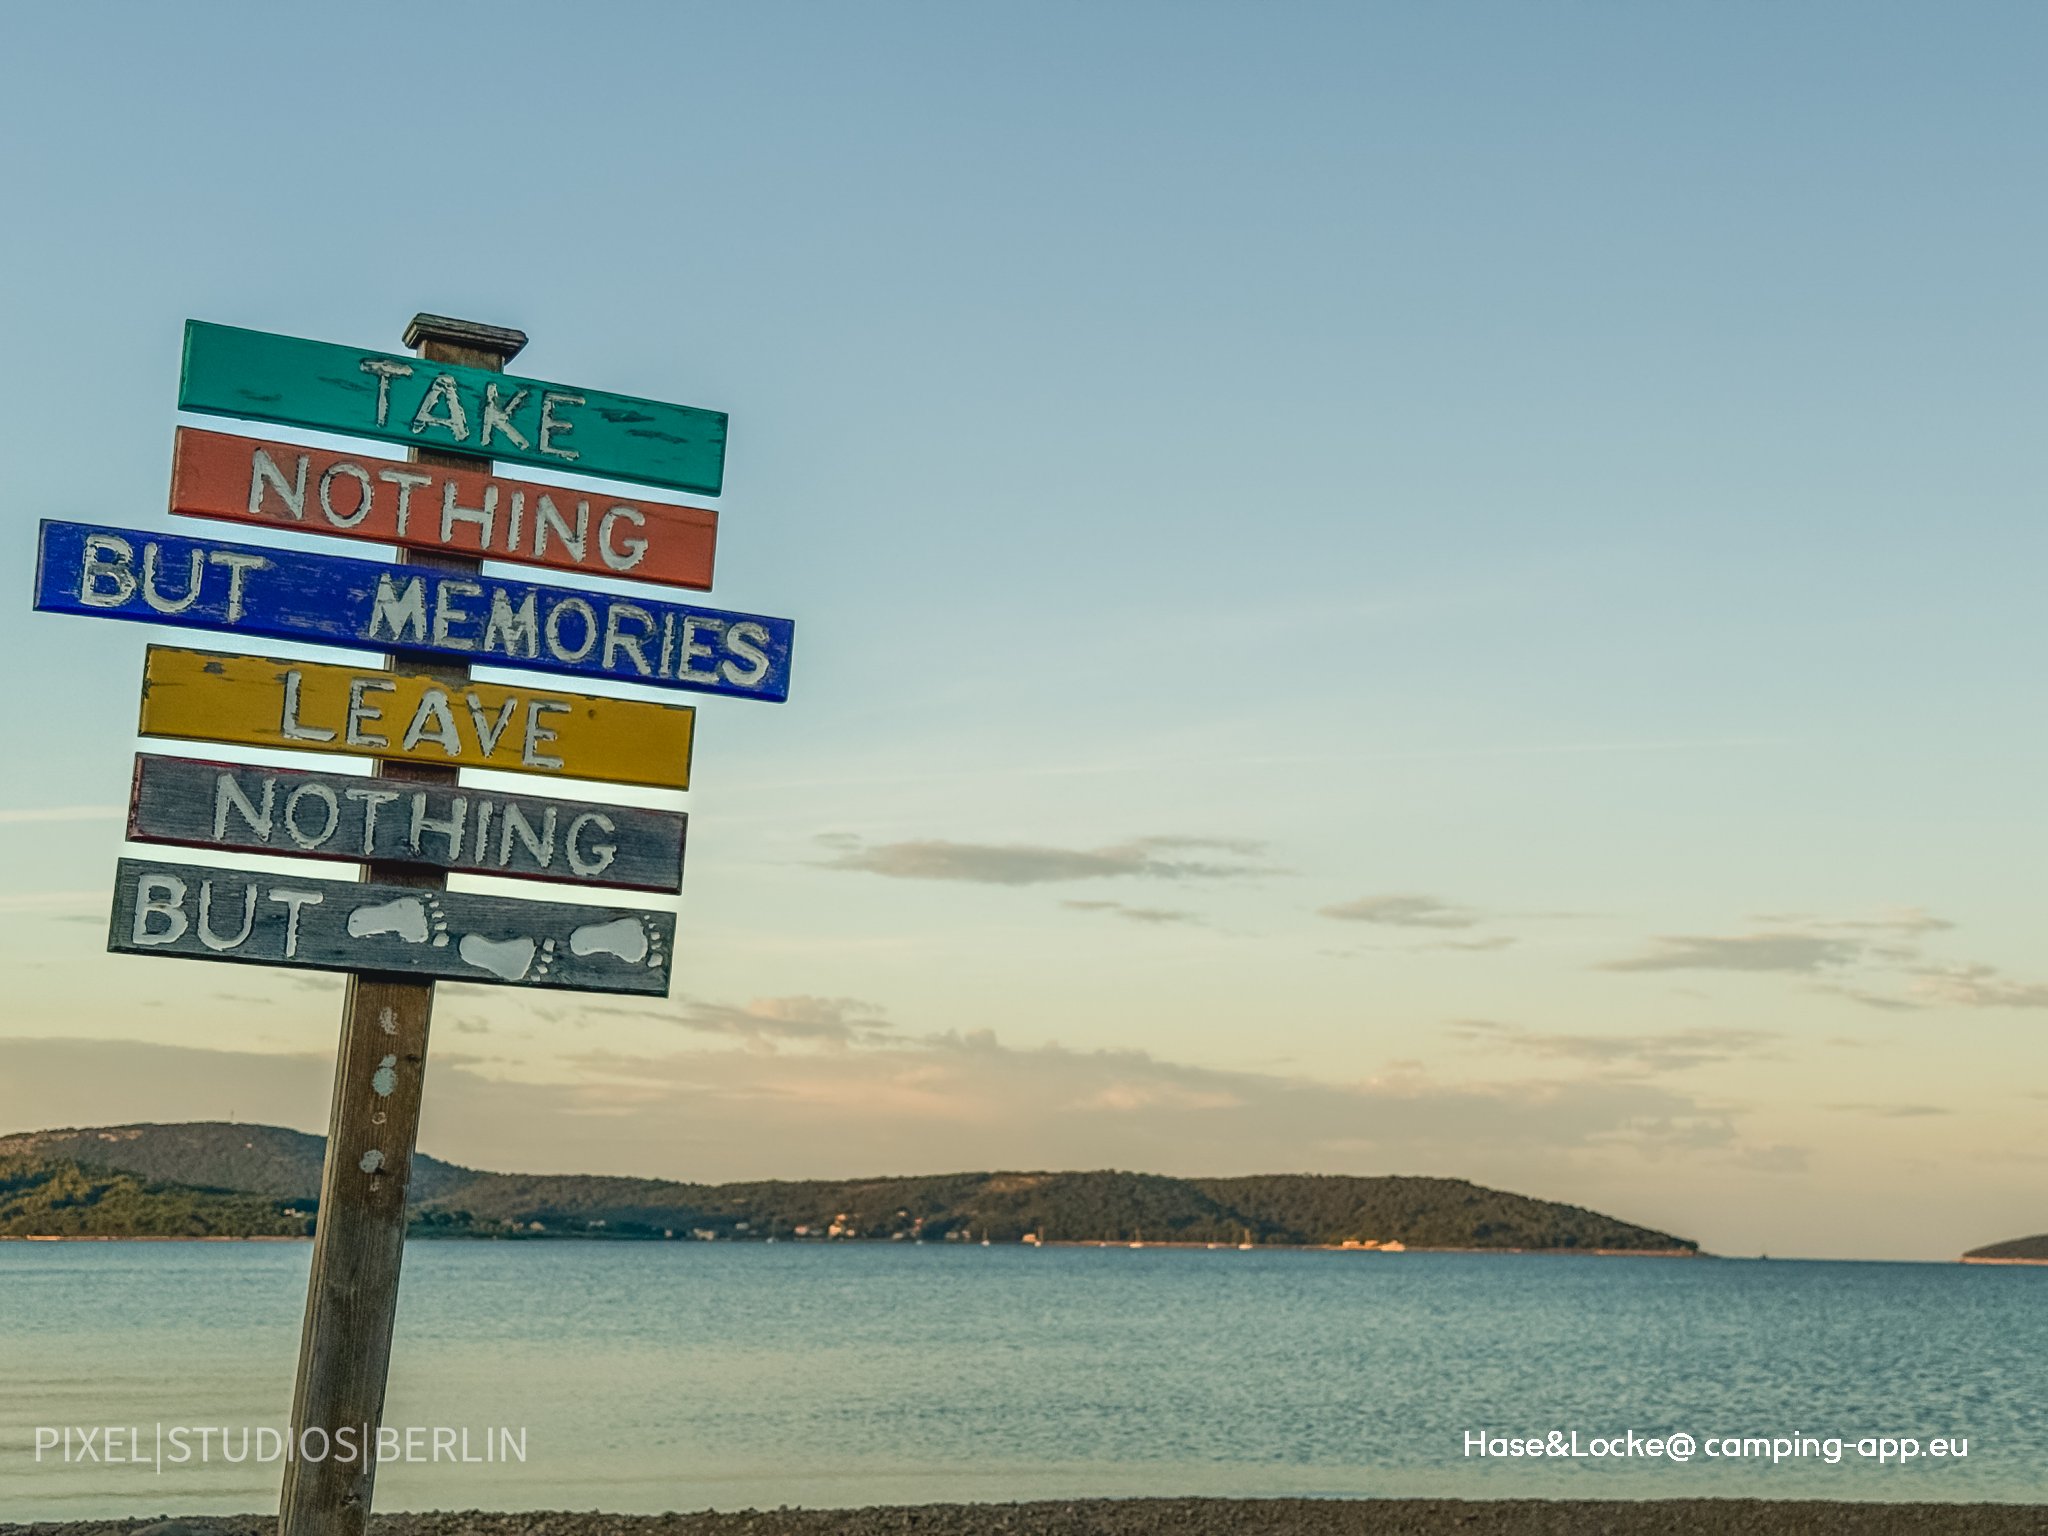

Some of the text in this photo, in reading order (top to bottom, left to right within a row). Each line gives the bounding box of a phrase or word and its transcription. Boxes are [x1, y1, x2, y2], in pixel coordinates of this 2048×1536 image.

[359, 358, 587, 461] TAKE
[247, 447, 650, 573] NOTHING
[80, 534, 772, 688] BUT MEMORIES
[281, 671, 573, 769] LEAVE
[212, 772, 618, 877] NOTHING
[131, 873, 325, 959] BUT
